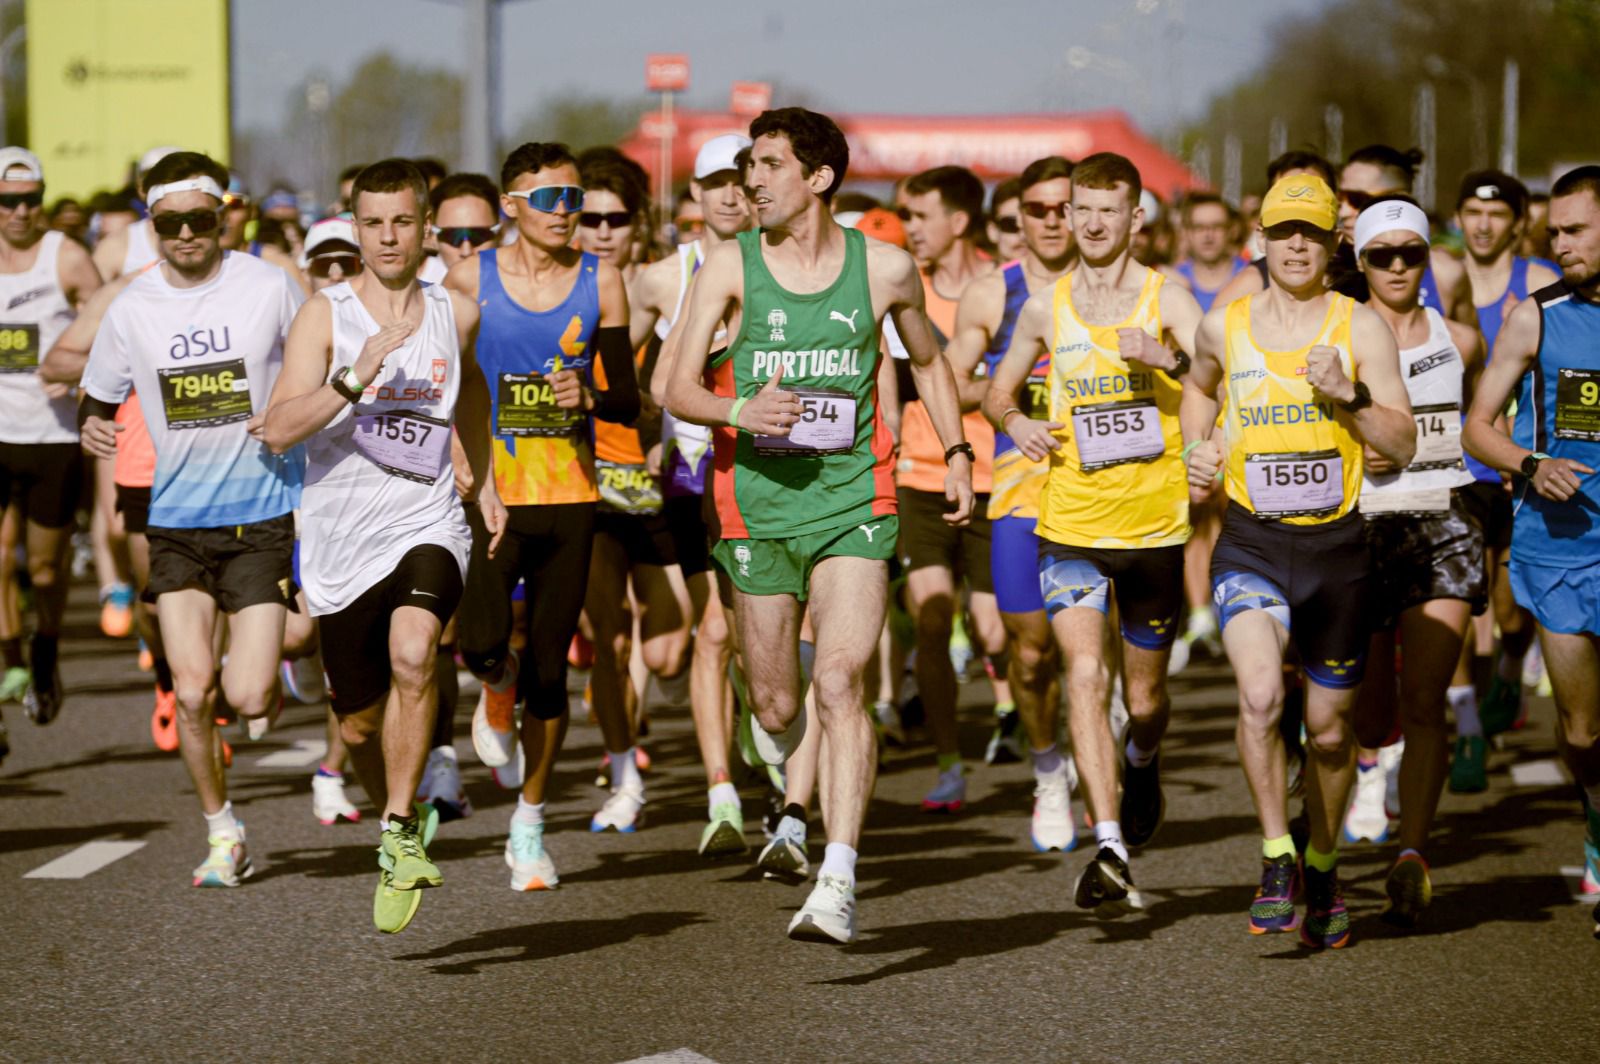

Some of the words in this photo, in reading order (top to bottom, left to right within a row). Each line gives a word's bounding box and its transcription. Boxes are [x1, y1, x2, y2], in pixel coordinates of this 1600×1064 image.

[0, 329, 29, 351] 98
[752, 349, 861, 378] PORTUGAL
[169, 370, 235, 399] 7946
[363, 384, 443, 401] POLSKA
[510, 384, 556, 407] 104
[1065, 371, 1154, 399] SWEDEN
[1580, 381, 1600, 406] 9
[801, 399, 839, 424] 54
[1083, 410, 1145, 437] 1553
[1239, 401, 1335, 428] SWEDEN
[374, 415, 432, 448] 1557
[1416, 415, 1446, 437] 14
[1262, 462, 1328, 487] 1550
